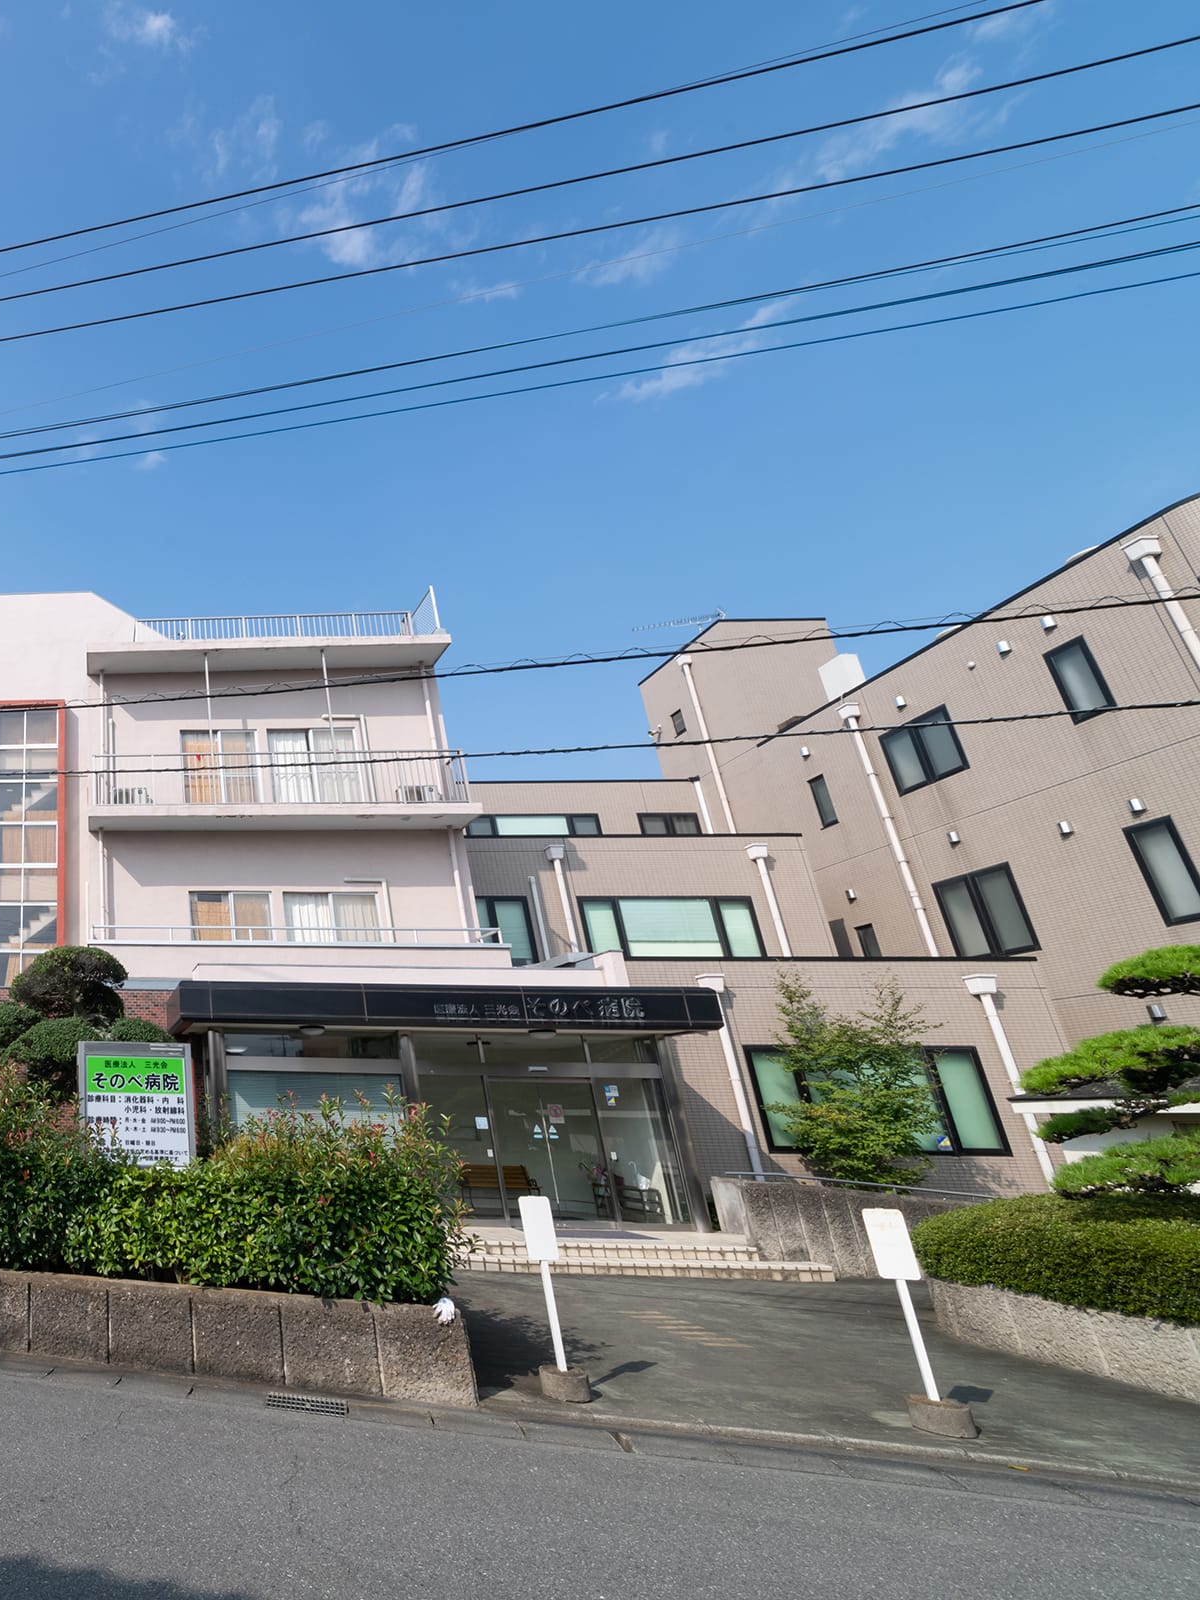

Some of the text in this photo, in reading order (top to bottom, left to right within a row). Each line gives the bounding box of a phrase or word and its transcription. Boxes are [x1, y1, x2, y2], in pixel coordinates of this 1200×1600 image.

[433, 1003, 480, 1015] 医療法人
[527, 997, 646, 1018] そのべ病院
[104, 1060, 168, 1070] 医療法人 三光会
[92, 1072, 180, 1091] そのべ病院
